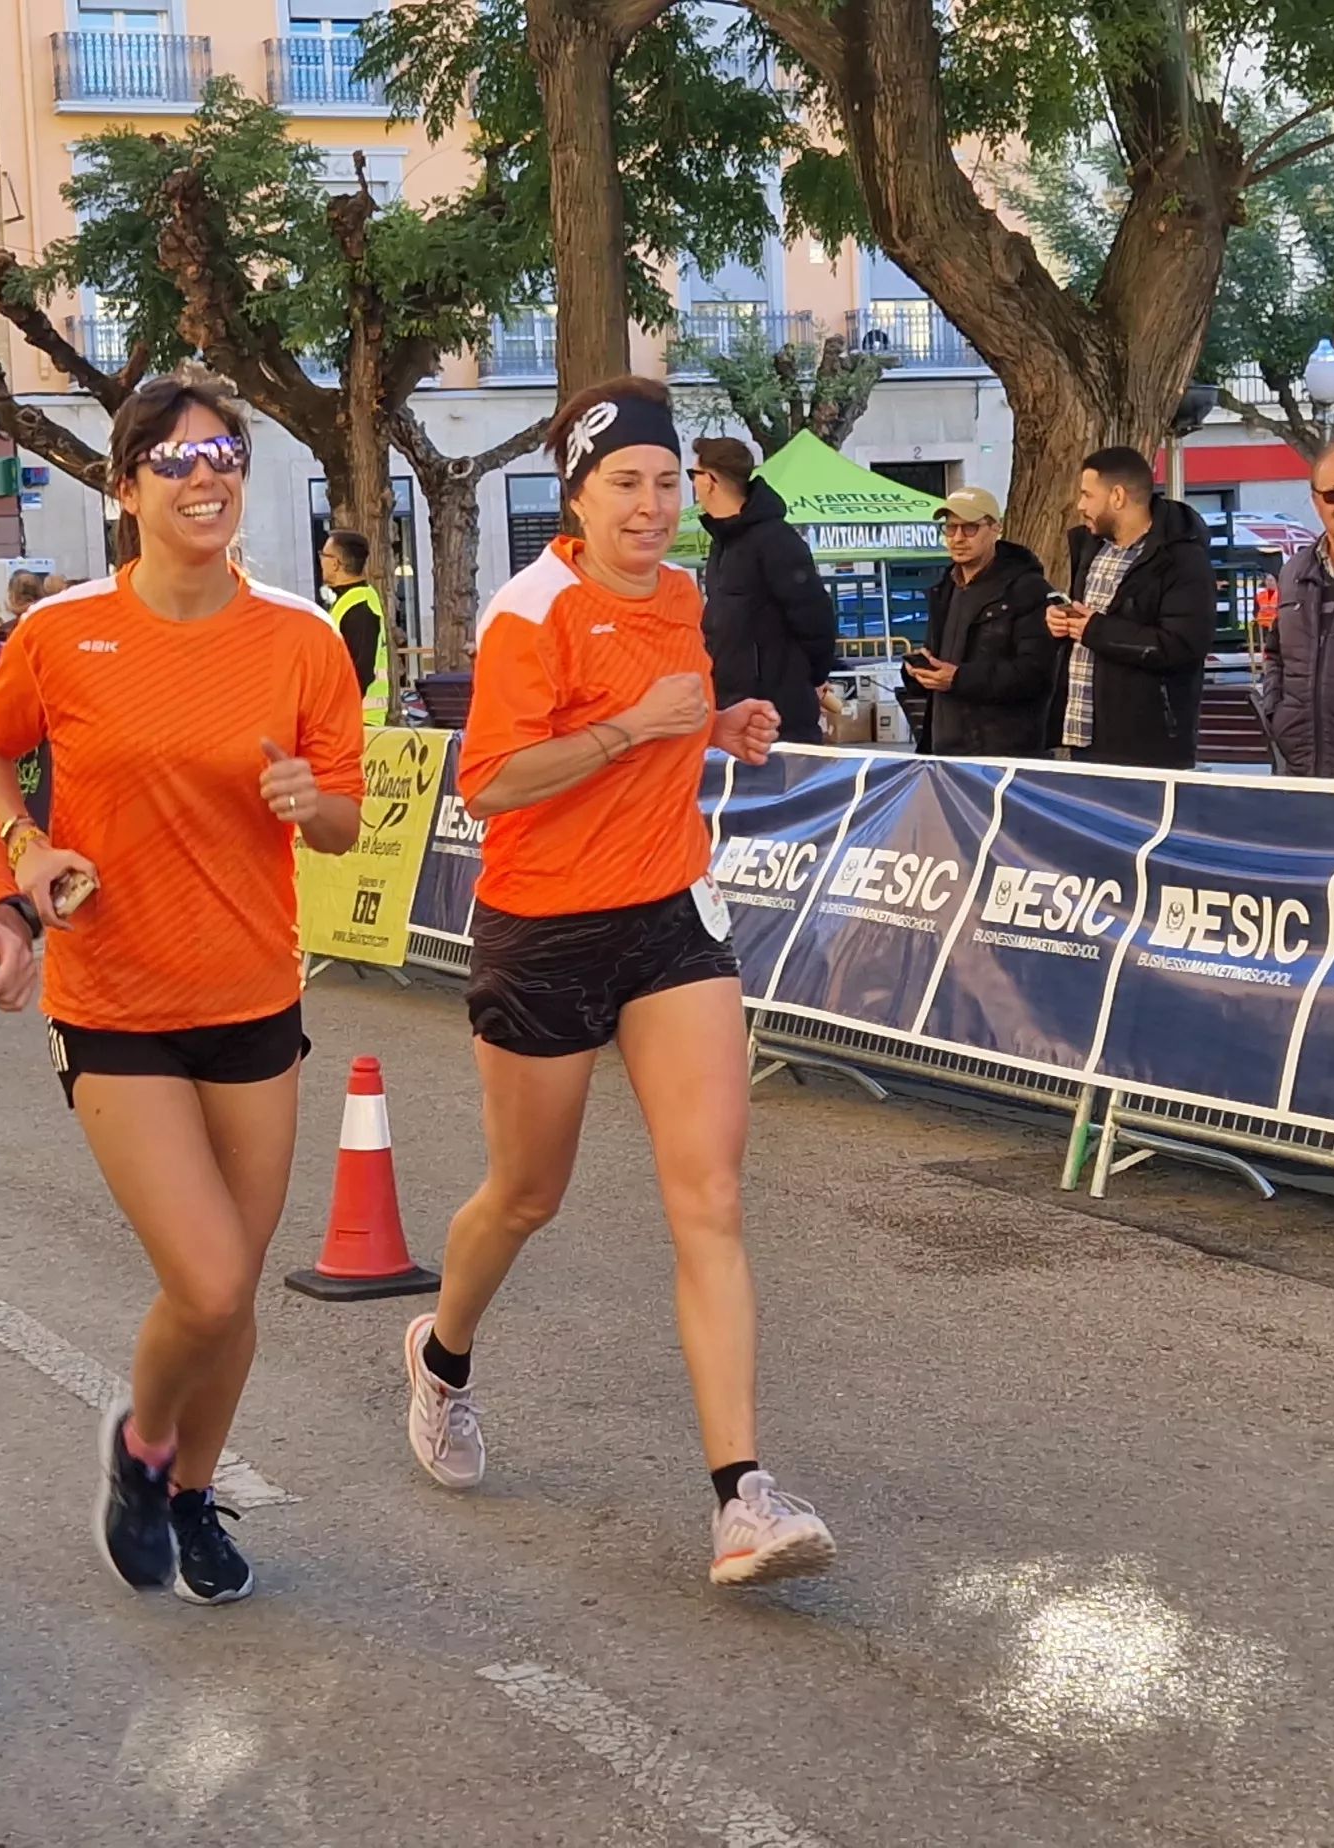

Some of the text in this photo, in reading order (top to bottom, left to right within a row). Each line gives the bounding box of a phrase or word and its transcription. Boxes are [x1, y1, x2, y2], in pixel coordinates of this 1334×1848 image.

[913, 446, 923, 459] 2
[812, 492, 907, 505] FARTLECK
[827, 505, 915, 516] SPORT
[819, 524, 938, 549] AVITUALLAMIENTO
[734, 839, 817, 892] ESIC
[856, 848, 959, 912] ESIC
[1013, 867, 1123, 937] ESIC
[1187, 895, 1310, 965] ESIC
